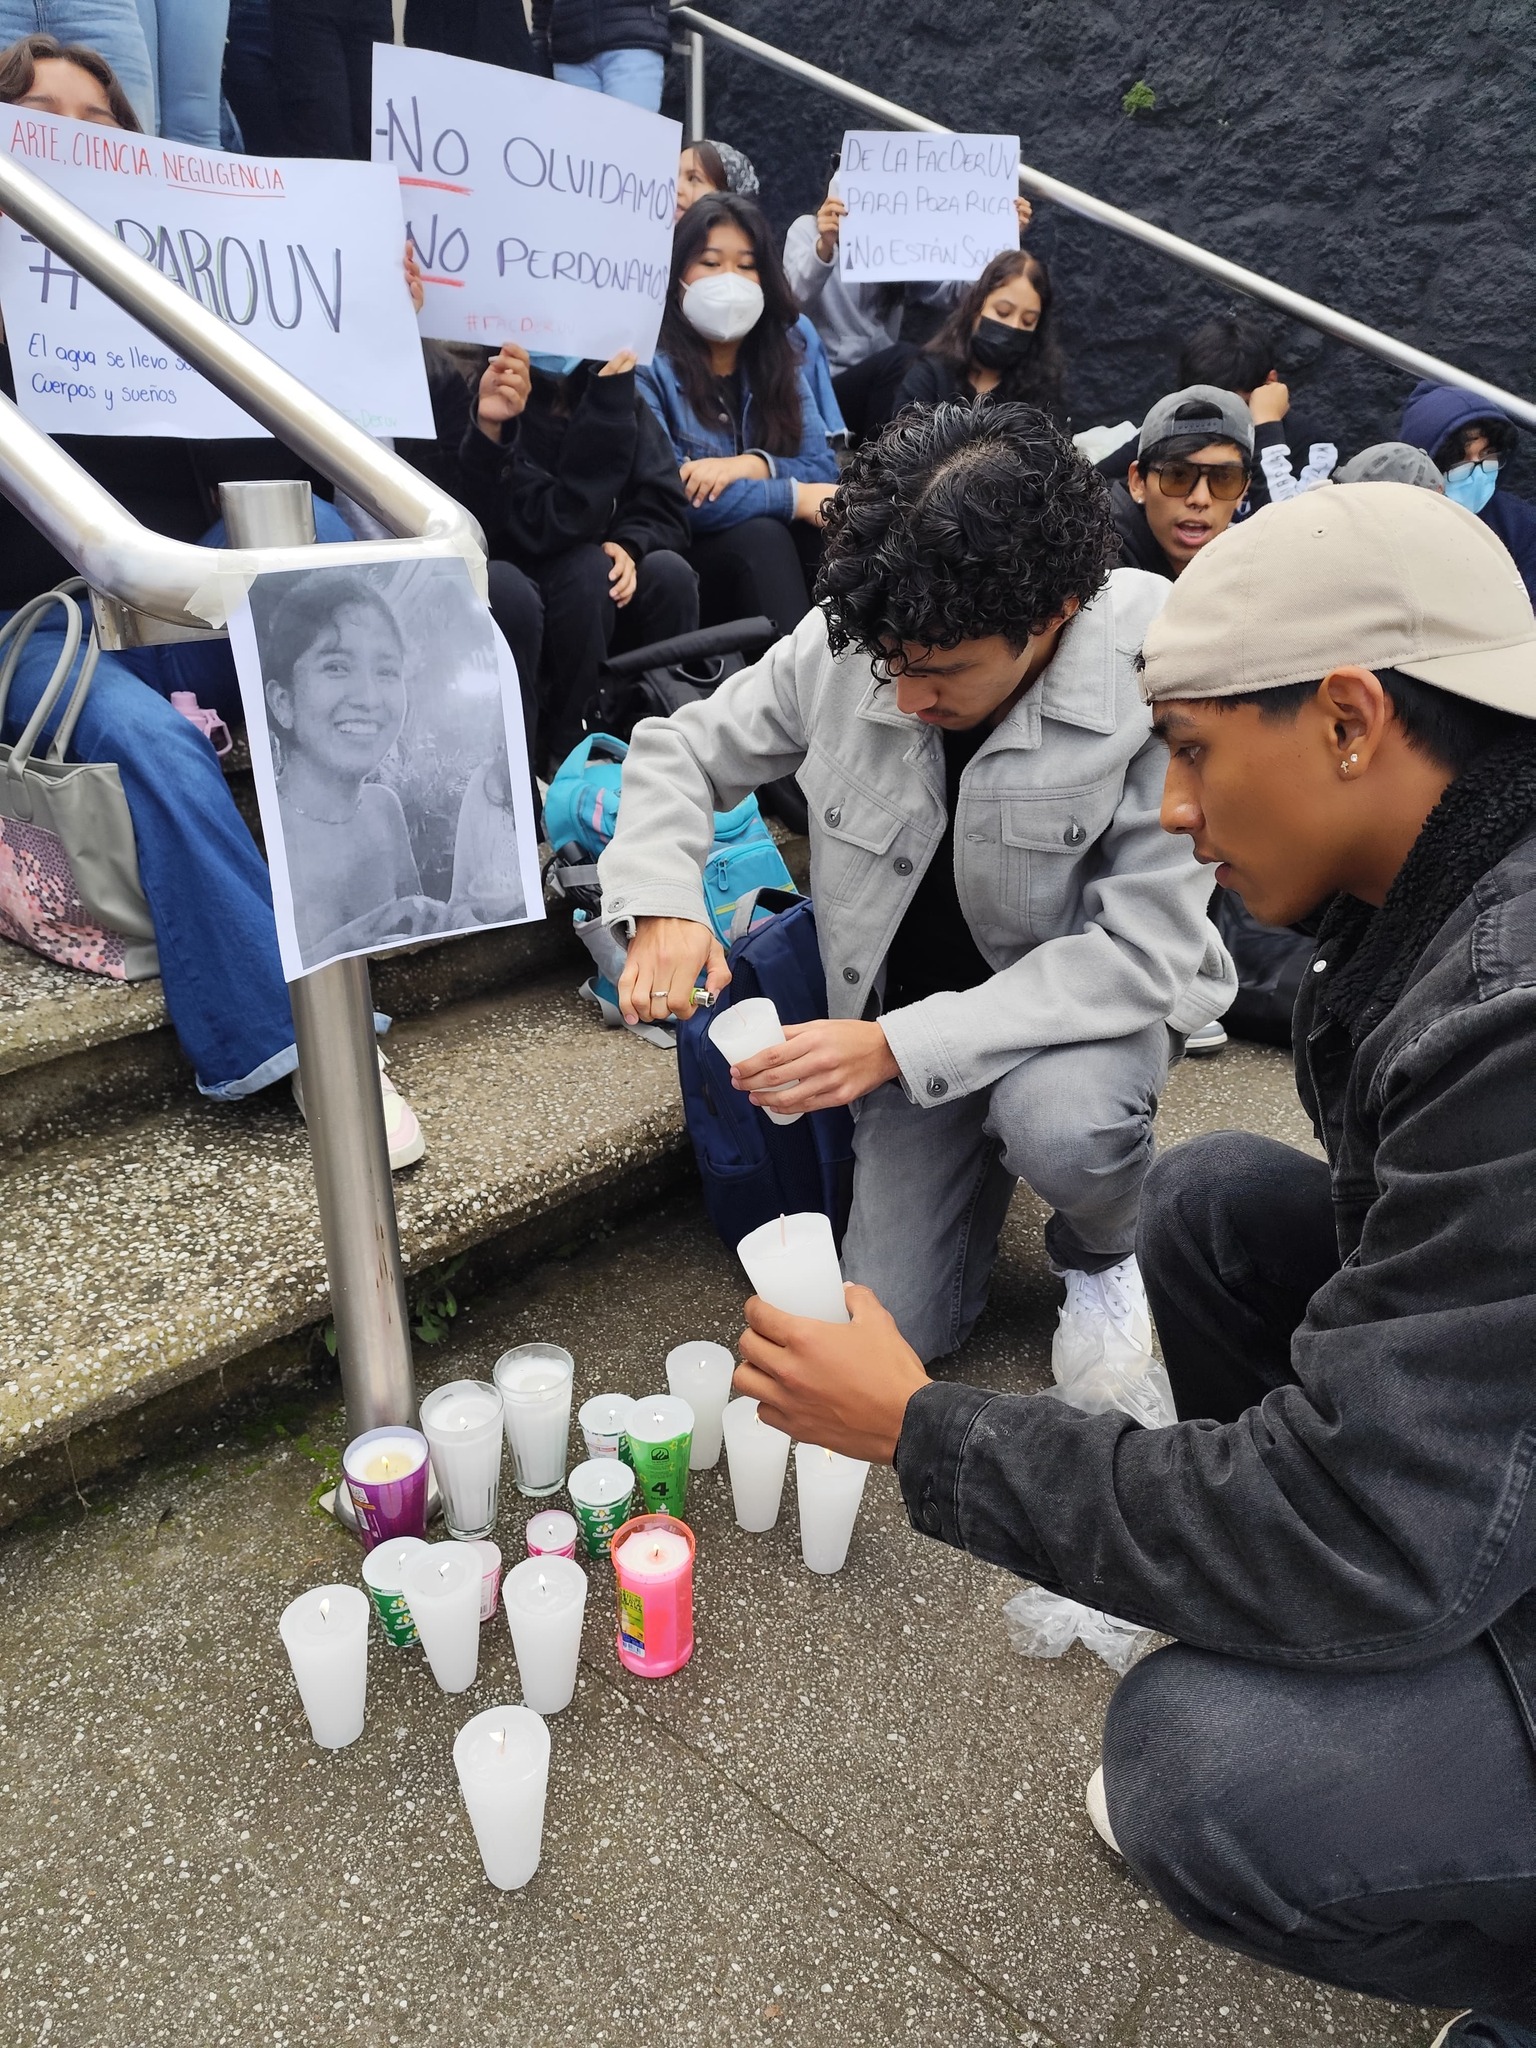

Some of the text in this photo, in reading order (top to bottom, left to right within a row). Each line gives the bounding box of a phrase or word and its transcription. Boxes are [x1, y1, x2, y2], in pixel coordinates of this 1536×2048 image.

[10, 119, 67, 165] ARTE,
[162, 151, 285, 190] NEGLIGENCIA
[846, 138, 873, 173] DE
[882, 139, 908, 173] LA
[503, 136, 677, 230] OLVIDAMOS
[847, 186, 908, 215] PARA
[406, 213, 669, 305] NO PERDONAMOS
[28, 333, 47, 357] El
[55, 346, 96, 371] agua
[106, 351, 125, 368] se
[129, 346, 168, 370] llevo
[32, 372, 177, 411] Cuerpos y sueños
[651, 1481, 670, 1496] 4
